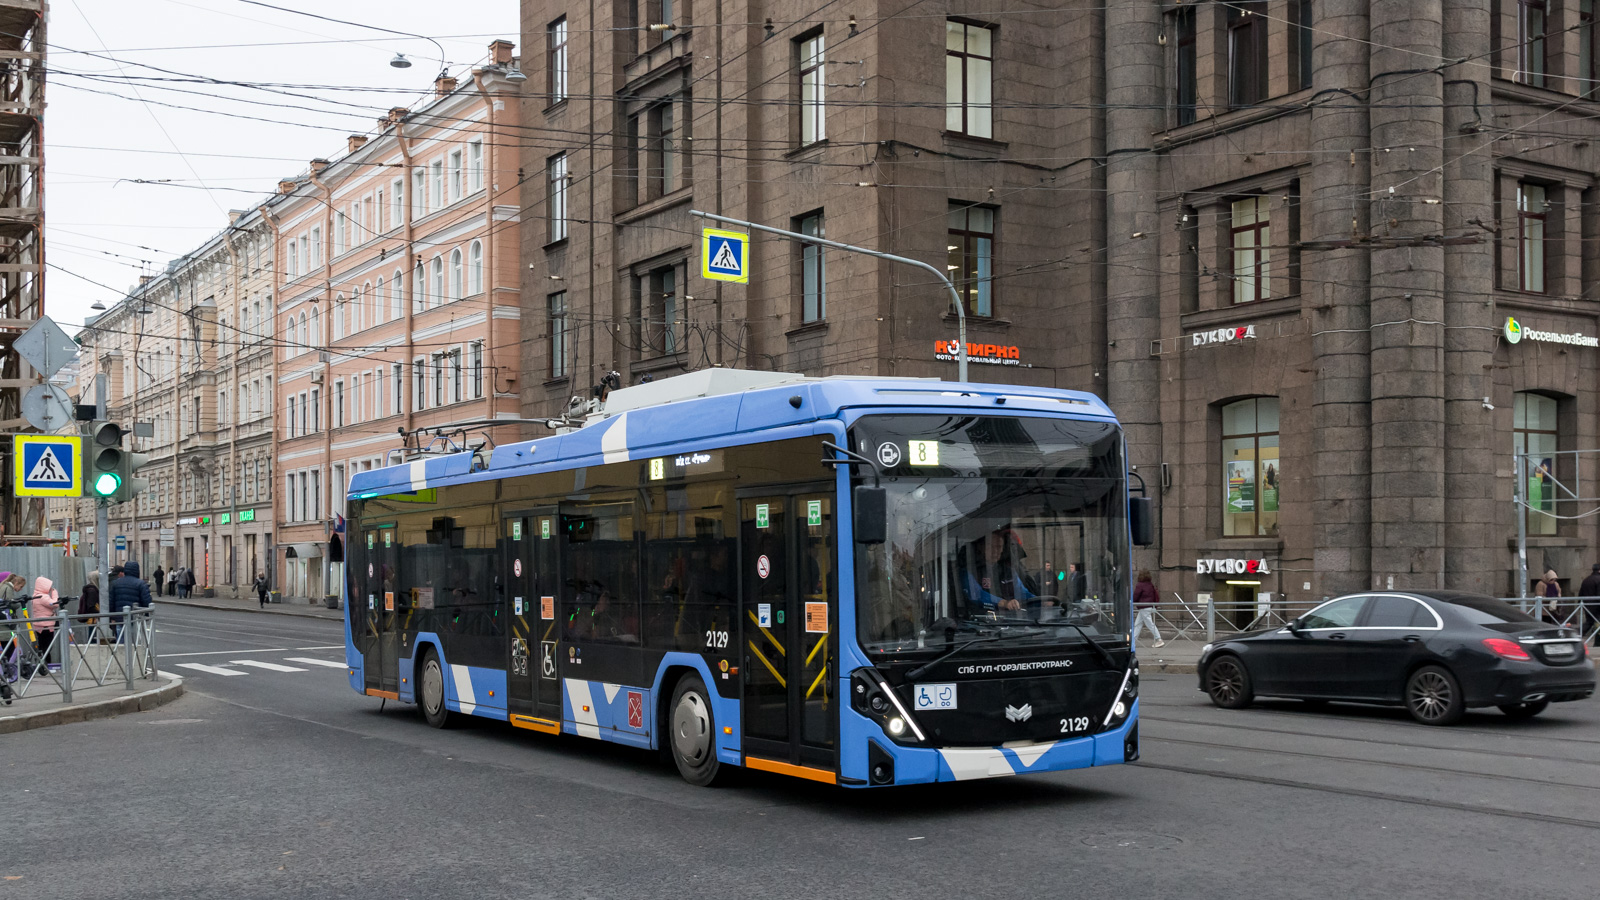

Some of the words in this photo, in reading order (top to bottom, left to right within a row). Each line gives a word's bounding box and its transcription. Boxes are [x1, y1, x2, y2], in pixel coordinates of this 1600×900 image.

[1523, 326, 1599, 348] РоссельхозБанк
[706, 630, 729, 648] 2129
[957, 665, 975, 675] СПб
[975, 664, 993, 673] ГУП
[993, 659, 1074, 672] «ГОРЭЛЕКТРОТРАНС»
[1059, 716, 1090, 733] 2129
